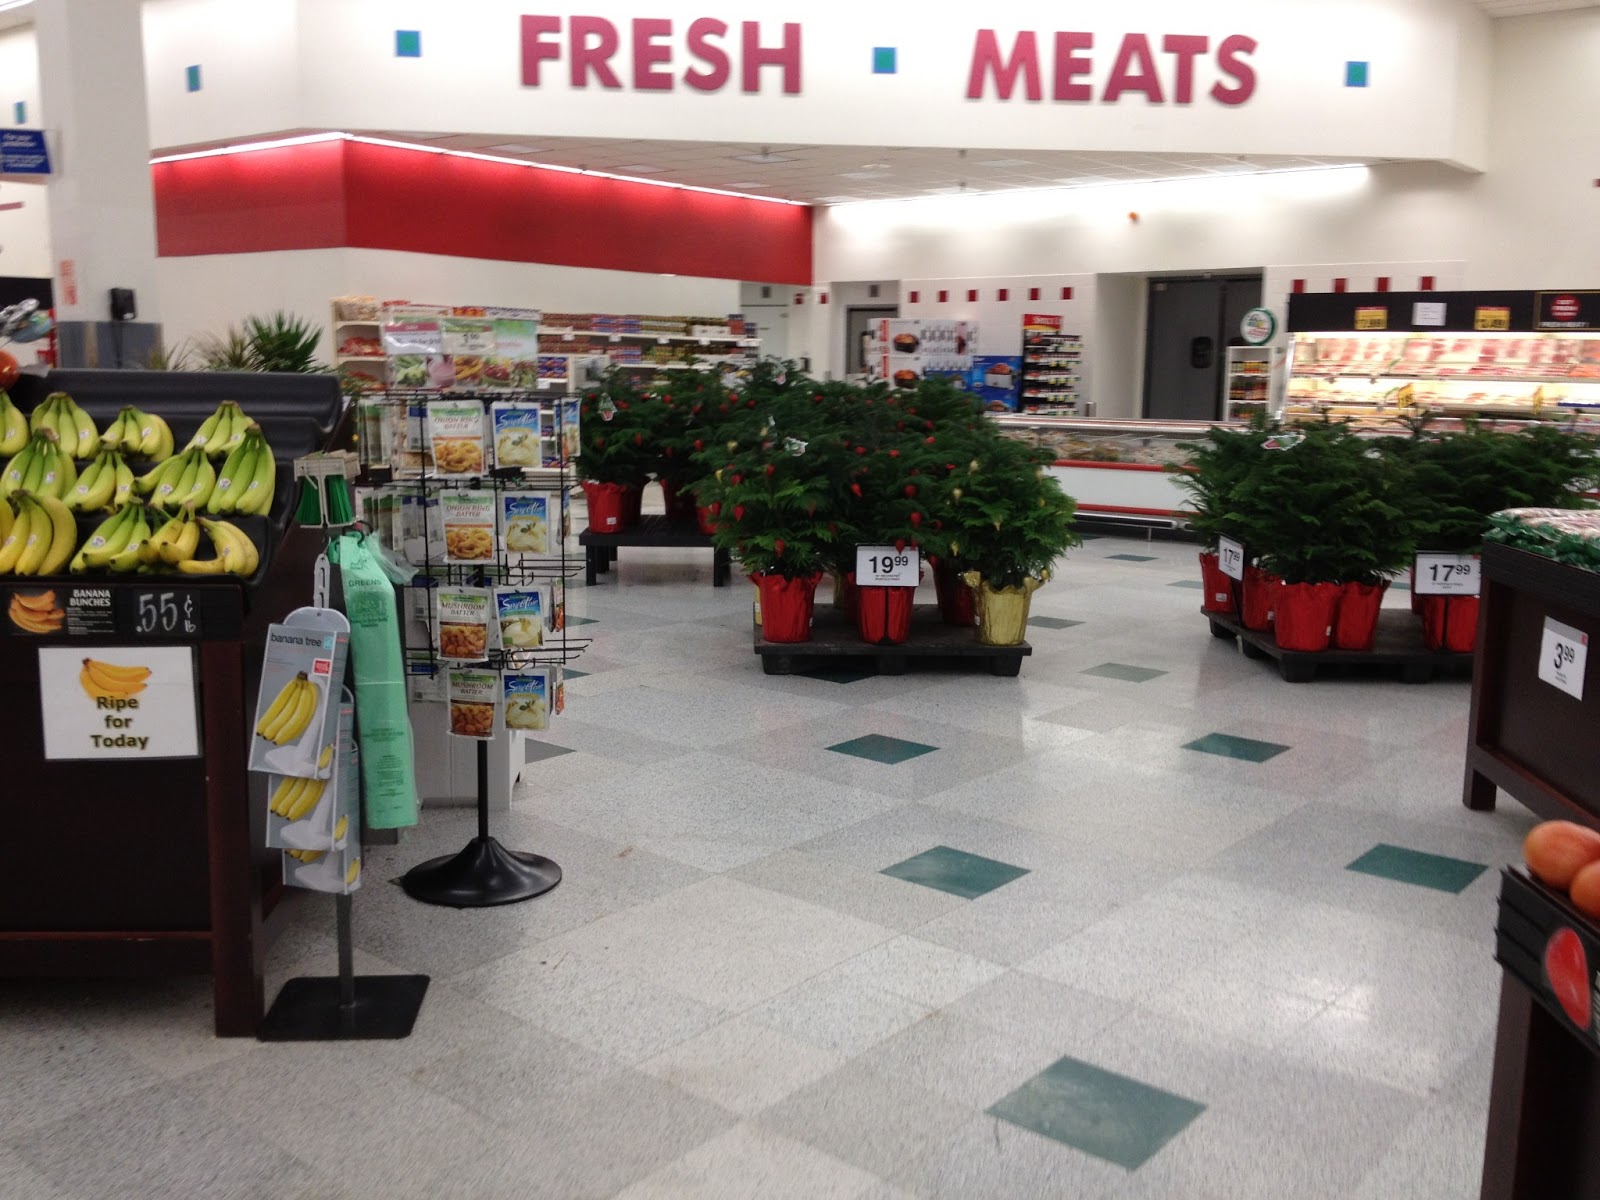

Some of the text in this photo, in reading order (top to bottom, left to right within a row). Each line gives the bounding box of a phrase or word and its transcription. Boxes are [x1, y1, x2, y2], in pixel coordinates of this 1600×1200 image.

[520, 14, 1258, 105] FRESH MEATS
[73, 589, 111, 598] BANANA
[69, 598, 111, 607] BUNCHES
[271, 632, 322, 647] banana tree
[96, 695, 139, 712] Ripe
[105, 715, 132, 729] for
[90, 734, 149, 750] Today
